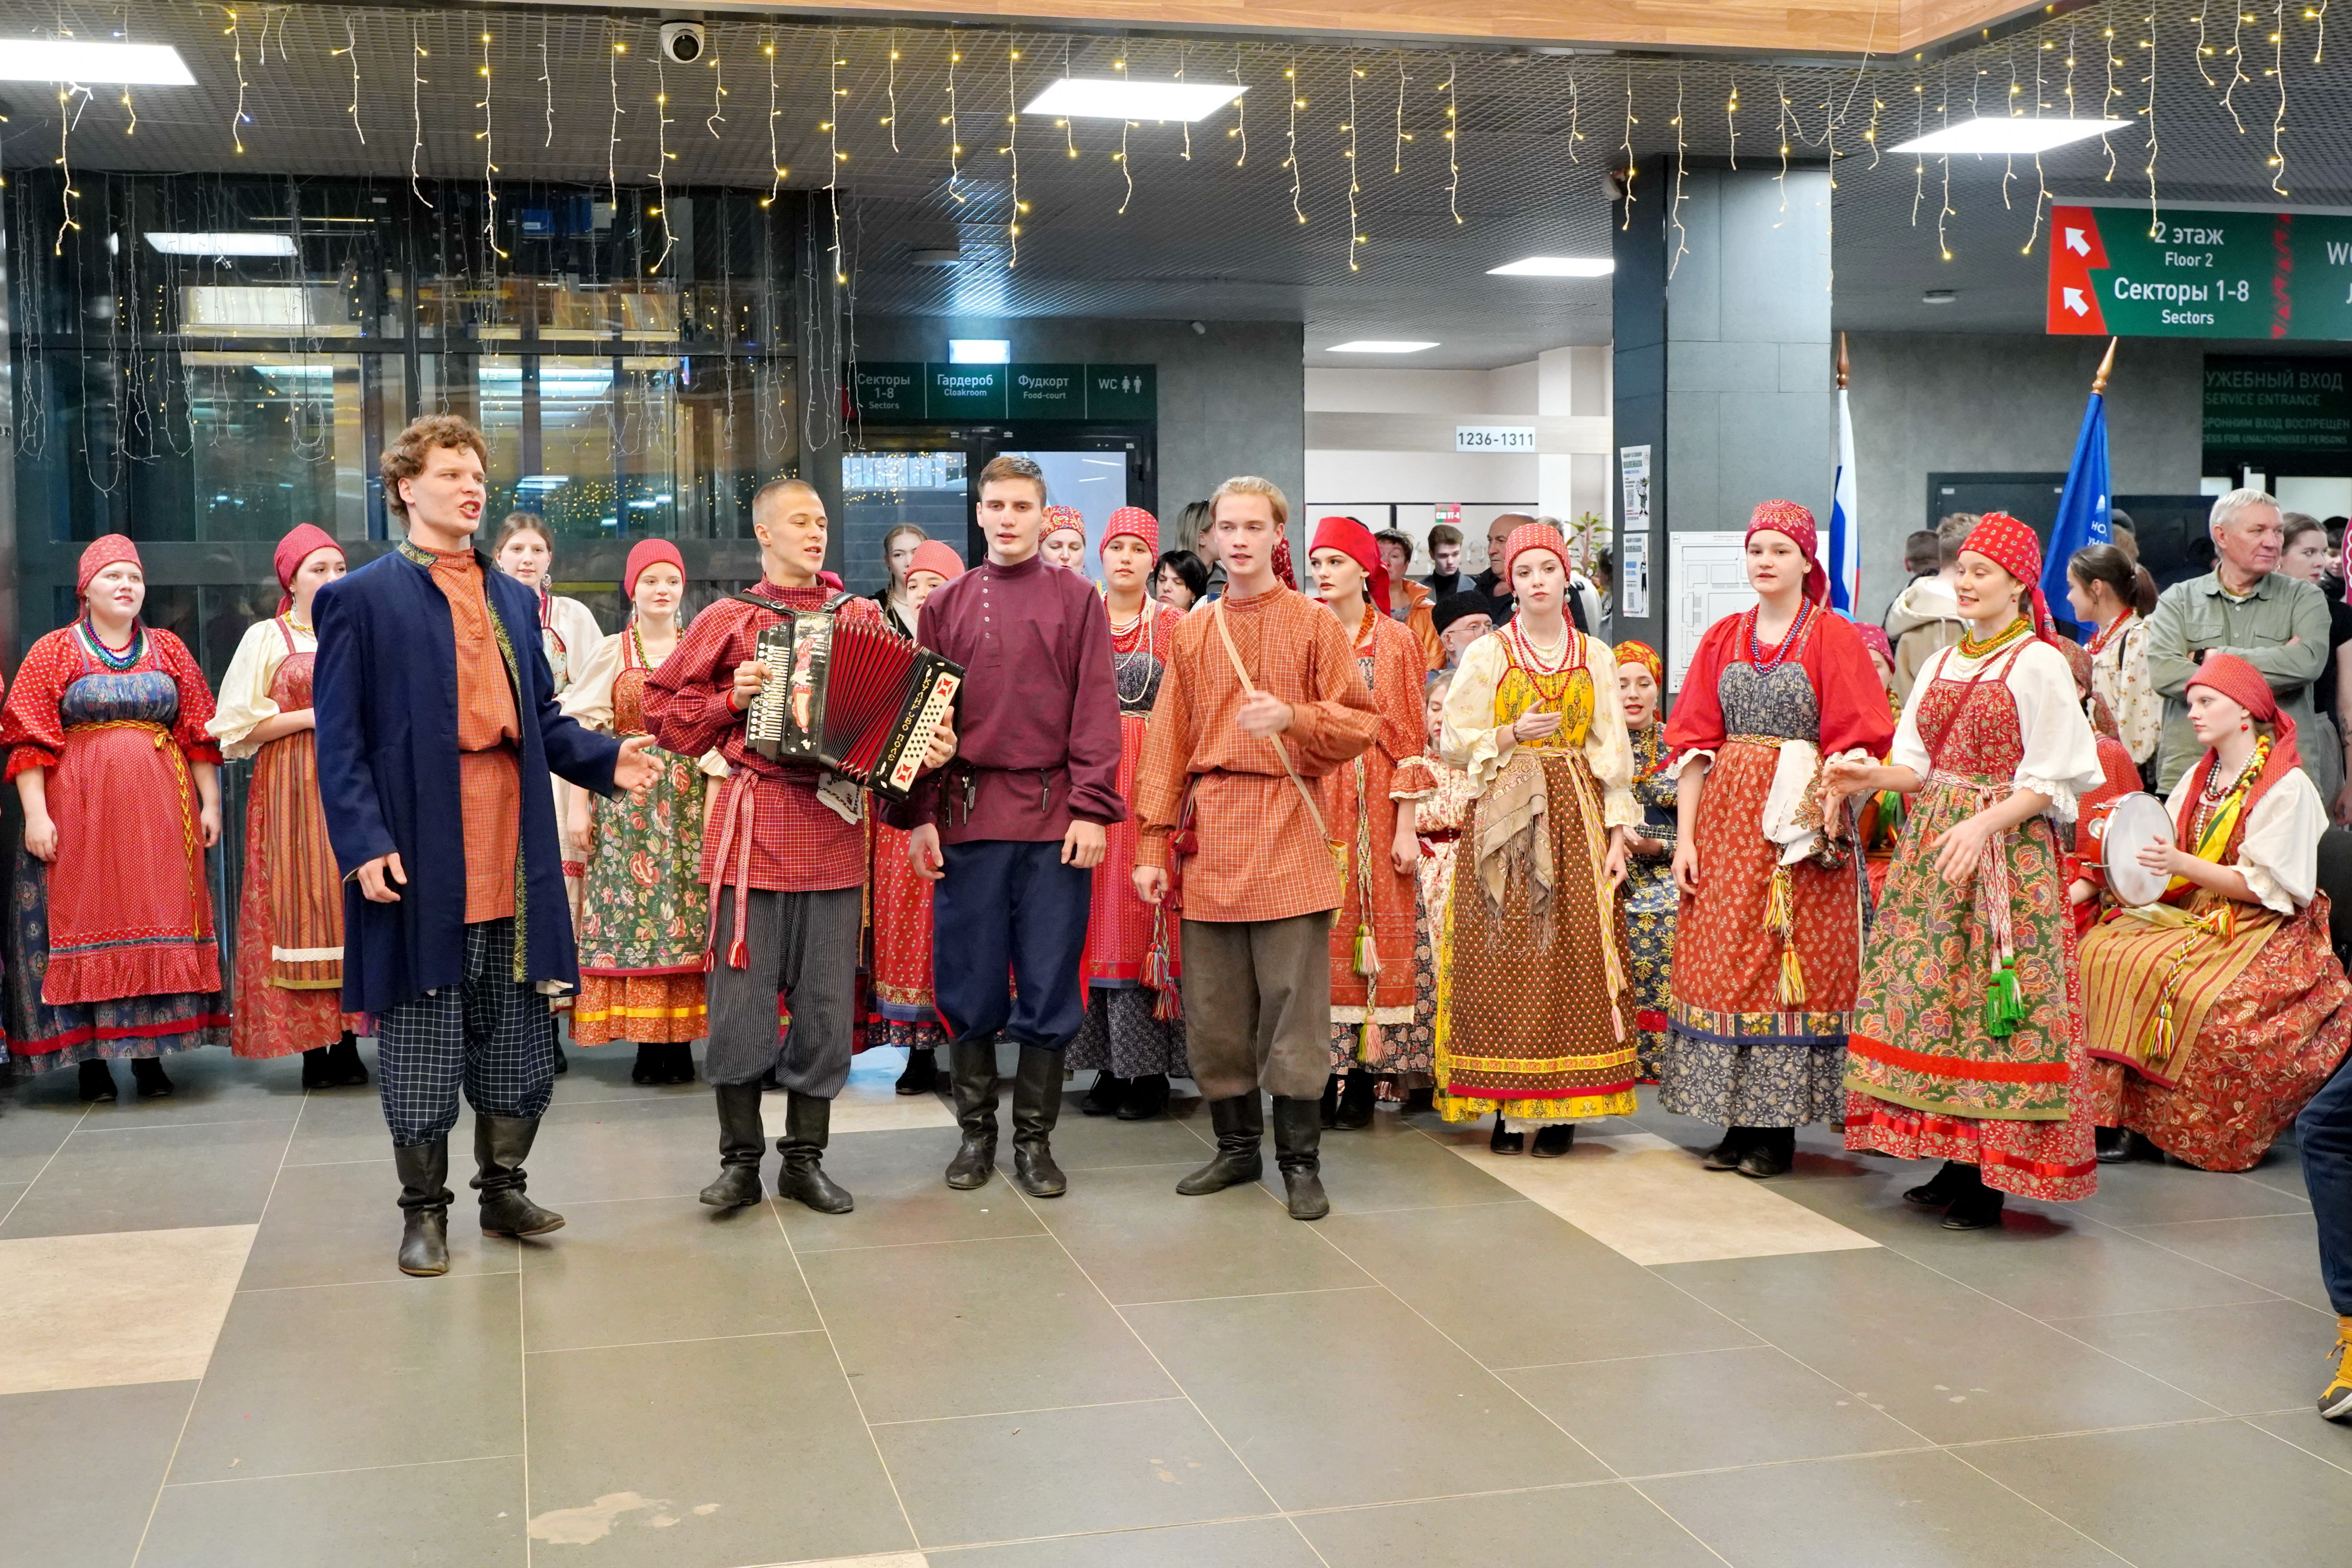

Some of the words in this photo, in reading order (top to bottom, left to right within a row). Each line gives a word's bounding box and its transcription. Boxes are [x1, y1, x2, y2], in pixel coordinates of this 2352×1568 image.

[2154, 222, 2166, 244] 2
[2173, 228, 2224, 245] этаж
[2165, 252, 2201, 267] Floor
[2205, 253, 2213, 267] 2
[2327, 241, 2352, 266] W
[2114, 277, 2208, 306] Секторы
[2216, 280, 2250, 302] 1-8
[2162, 309, 2215, 325] Sectors
[857, 373, 910, 387] Секторы
[937, 374, 994, 388] Гардероб
[1018, 375, 1069, 388] Фудкорт
[1098, 378, 1118, 389] WC
[2299, 372, 2344, 392] ВХОД
[875, 387, 894, 399] 1-8
[2205, 393, 2254, 405] SERVICE
[2257, 394, 2321, 407] ENTRANCE
[1458, 433, 1533, 446] 1236-1311
[2091, 521, 2107, 536] НО
